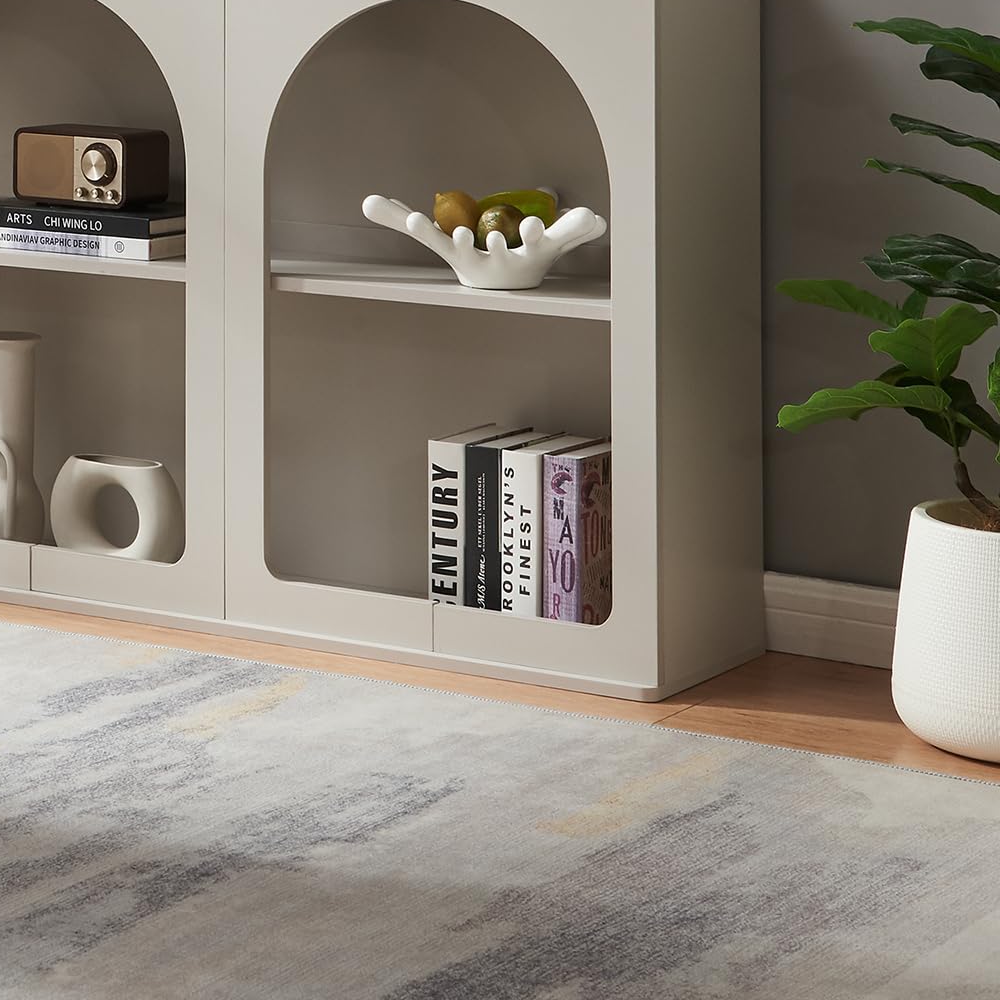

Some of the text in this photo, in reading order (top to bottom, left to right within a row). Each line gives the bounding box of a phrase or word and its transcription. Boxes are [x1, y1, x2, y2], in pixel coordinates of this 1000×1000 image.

[6, 212, 102, 232] ARTS CHI WING LO
[39, 236, 72, 248] GRAPHIC
[73, 239, 100, 250] DESIGN
[519, 504, 532, 597] FINEST
